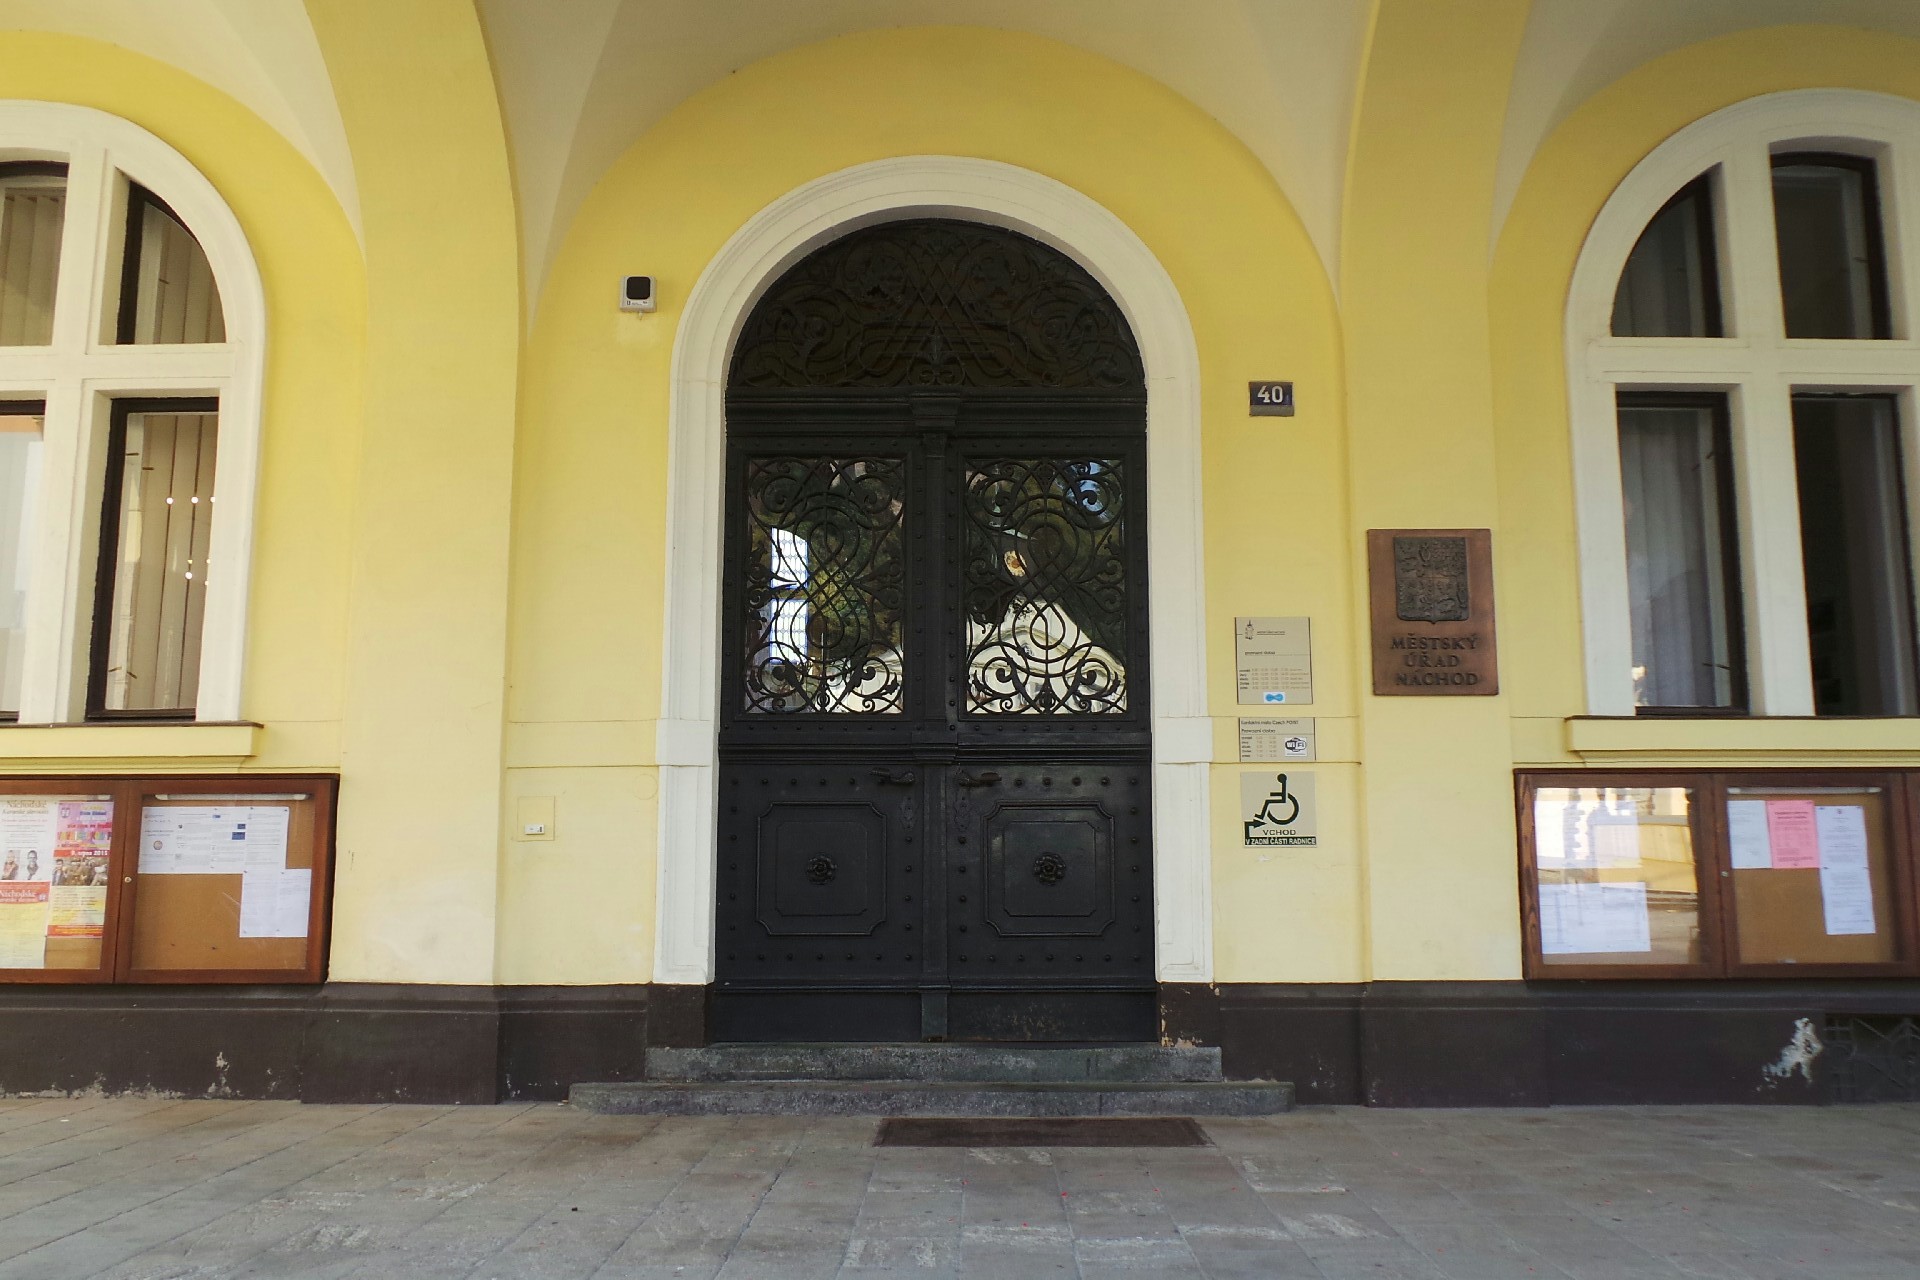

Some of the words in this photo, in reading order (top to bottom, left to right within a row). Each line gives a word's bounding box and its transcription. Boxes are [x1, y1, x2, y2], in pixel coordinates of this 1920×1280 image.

[1257, 385, 1284, 403] 40
[1391, 632, 1479, 650] MĚSTSKÝ
[1405, 651, 1460, 667] ÚŘAD
[1396, 669, 1479, 686] NÁCHOD
[1251, 837, 1269, 845] ZADNÍ
[1270, 837, 1288, 845] ČÁSTI
